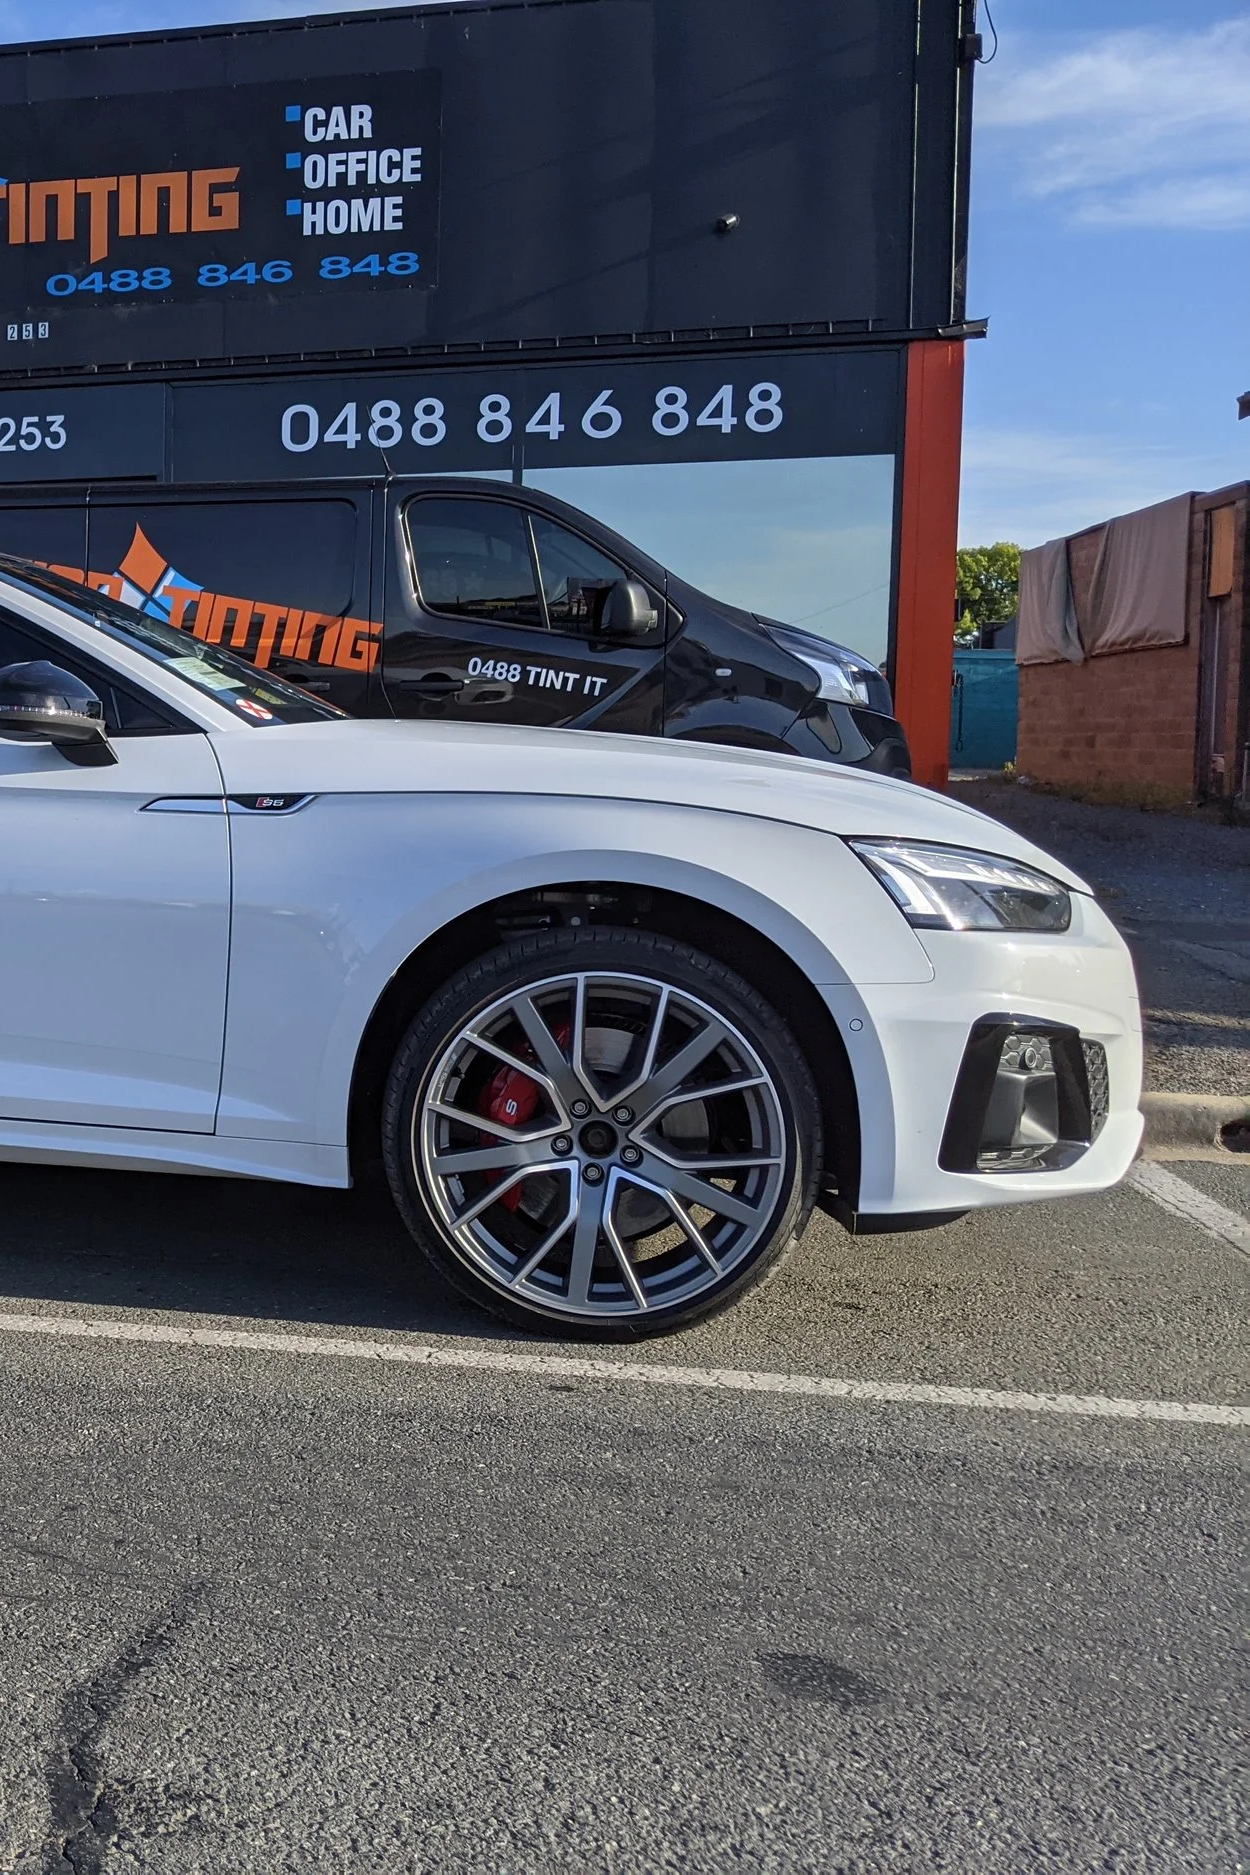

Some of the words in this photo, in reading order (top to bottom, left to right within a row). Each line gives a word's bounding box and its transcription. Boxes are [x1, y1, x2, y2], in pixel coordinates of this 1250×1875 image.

[304, 104, 373, 143] CAR
[303, 147, 422, 189] OFFICE
[302, 196, 403, 236] HOME
[46, 267, 172, 296] 0488
[197, 260, 293, 287] 846
[319, 252, 420, 280] 848
[9, 322, 48, 340] 253
[281, 397, 446, 452] 0488
[476, 386, 623, 442] 846
[652, 380, 784, 436] 848
[163, 585, 384, 672] TINTING
[467, 657, 521, 683] 0488
[526, 665, 580, 692] TINT
[584, 675, 608, 697] IT
